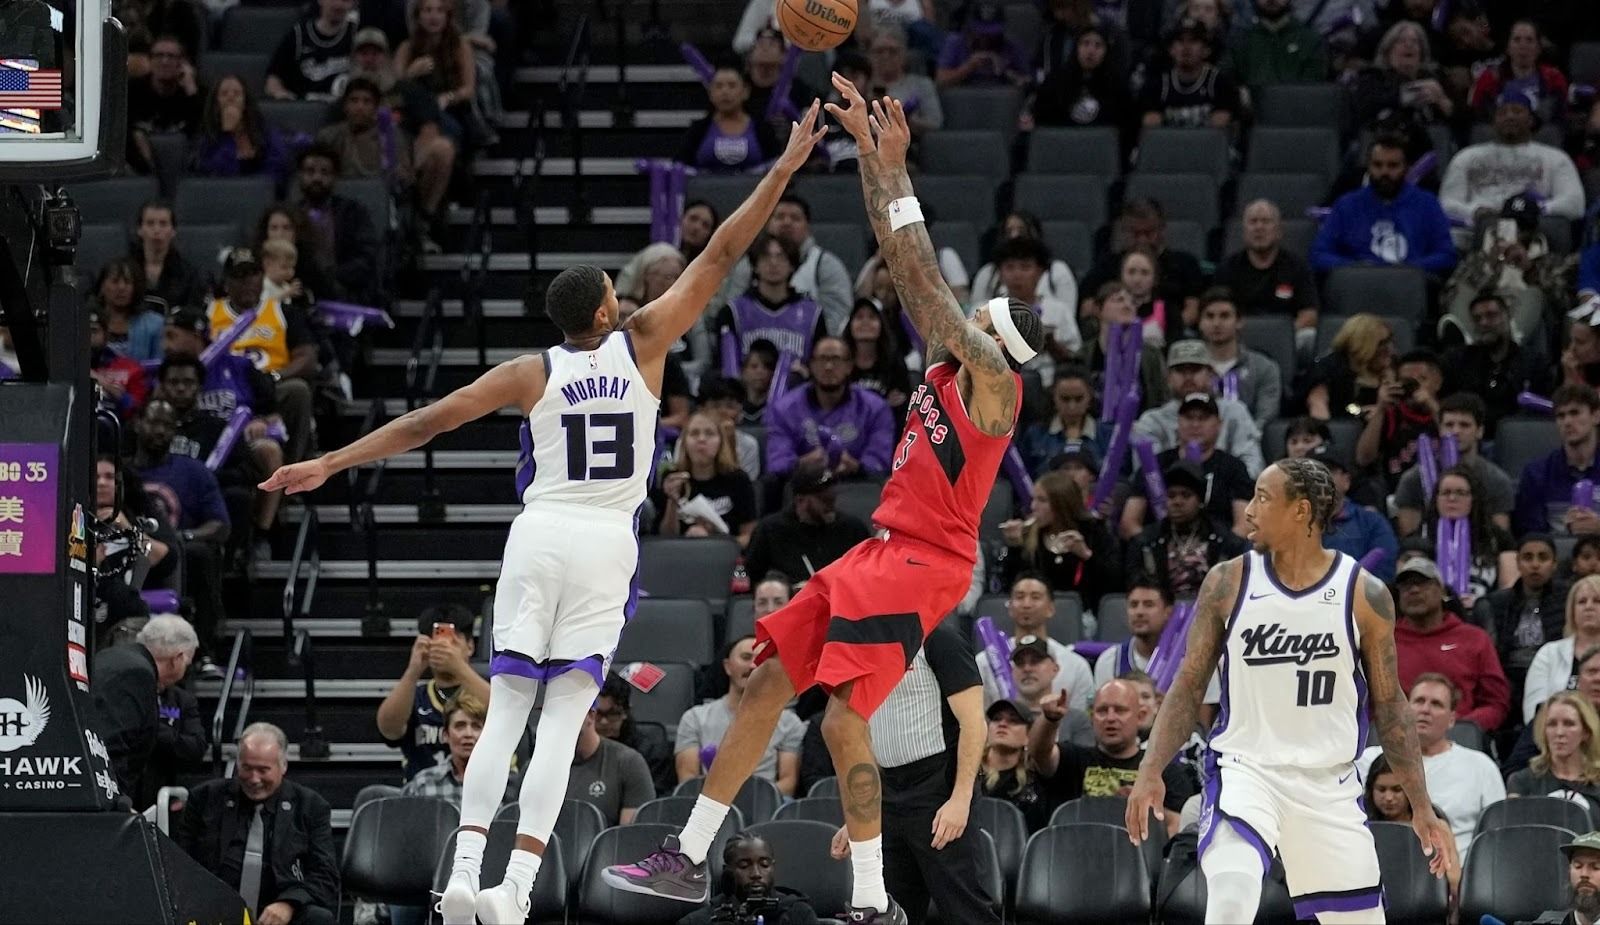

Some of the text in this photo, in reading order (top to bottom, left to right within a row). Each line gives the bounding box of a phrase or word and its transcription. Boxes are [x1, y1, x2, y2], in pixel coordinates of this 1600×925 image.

[805, 0, 851, 29] Wilson
[561, 375, 630, 406] MURRAY
[906, 385, 948, 444] PTORS
[561, 412, 634, 480] 13
[25, 462, 48, 482] 35
[1240, 624, 1340, 666] Kings
[1296, 670, 1336, 707] 10
[0, 757, 82, 775] HAWK
[15, 780, 65, 790] CASINO
